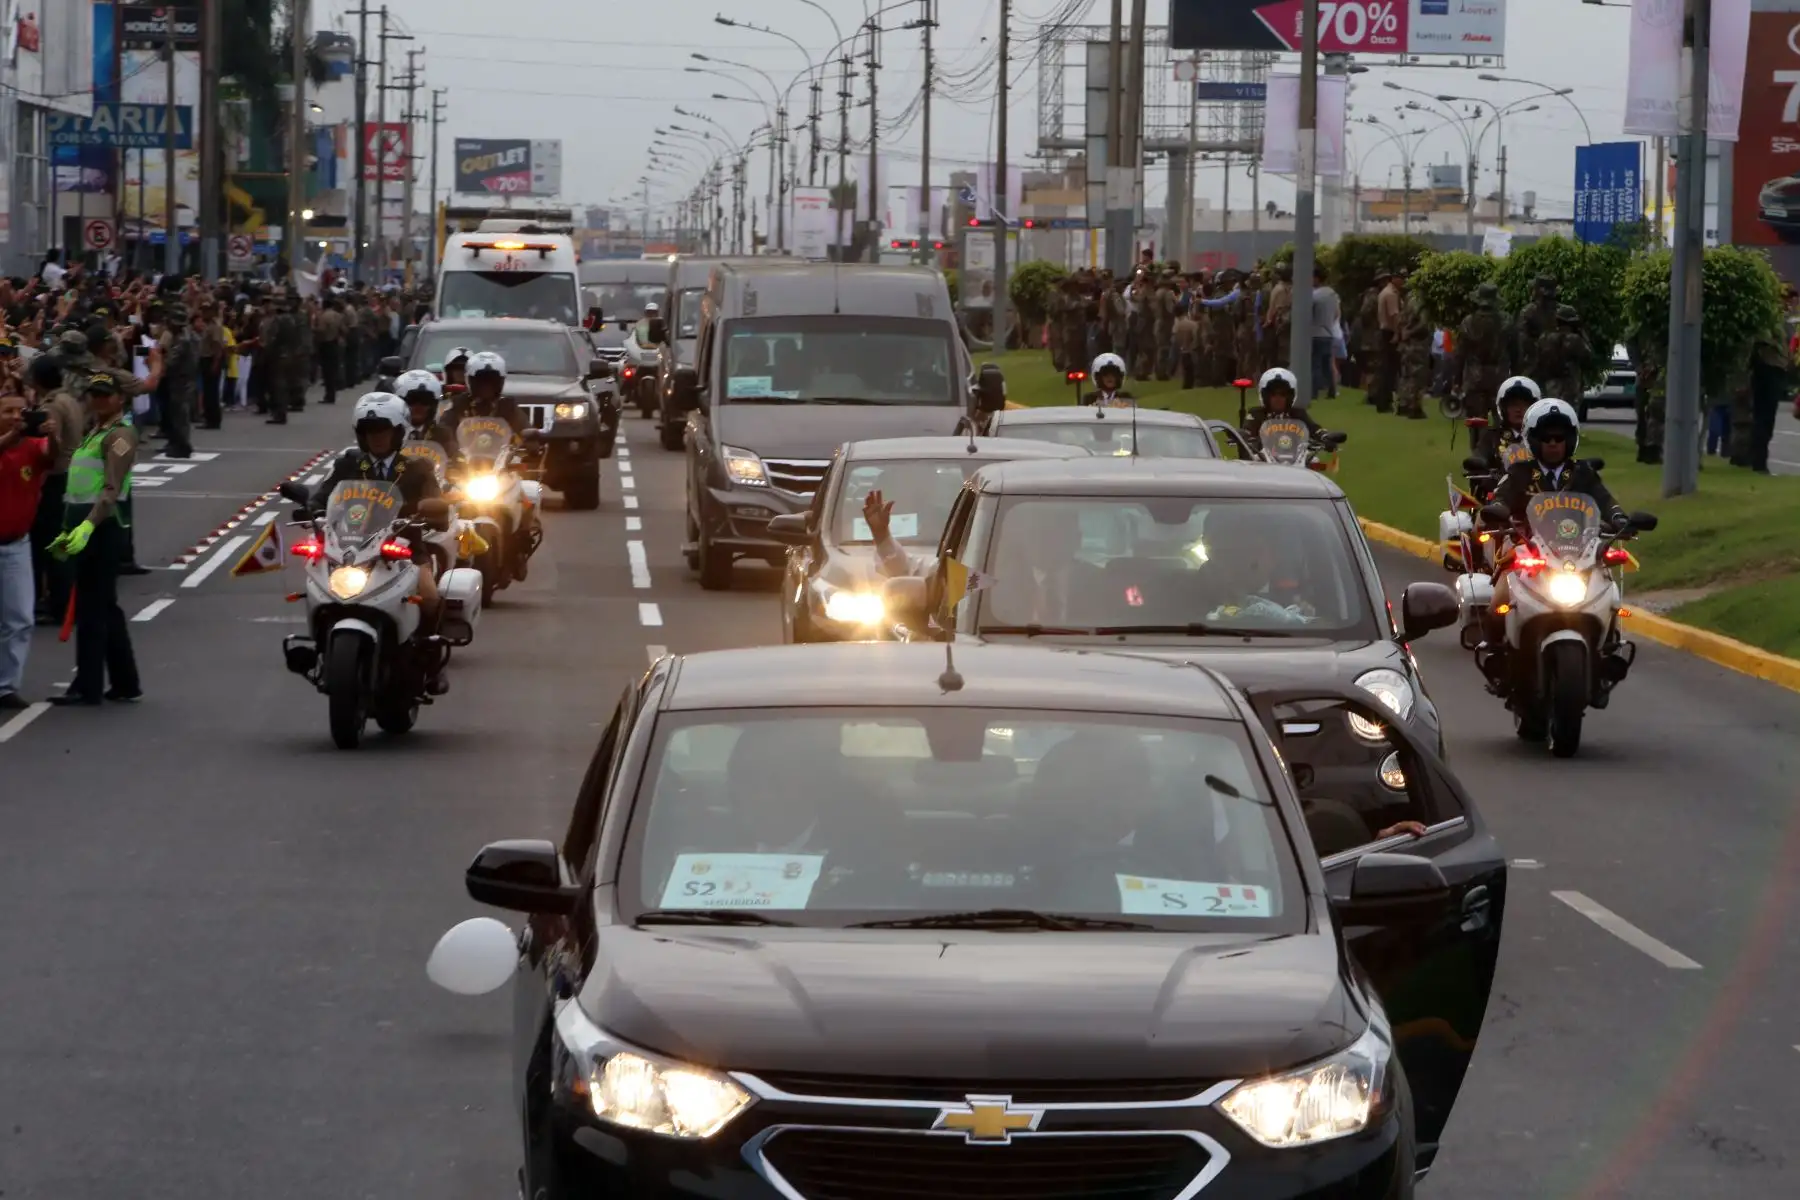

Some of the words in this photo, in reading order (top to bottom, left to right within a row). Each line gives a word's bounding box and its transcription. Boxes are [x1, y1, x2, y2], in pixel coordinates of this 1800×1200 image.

[1317, 2, 1397, 45] 70%
[461, 146, 527, 174] OUTLET
[1575, 189, 1585, 223] semi
[1589, 189, 1599, 223] semi
[1601, 189, 1611, 224] semi
[1615, 187, 1625, 223] semi
[1624, 168, 1634, 223] nuevos
[1264, 423, 1305, 439] POLICIA
[1534, 496, 1595, 518] POLICIA
[682, 880, 717, 897] S2
